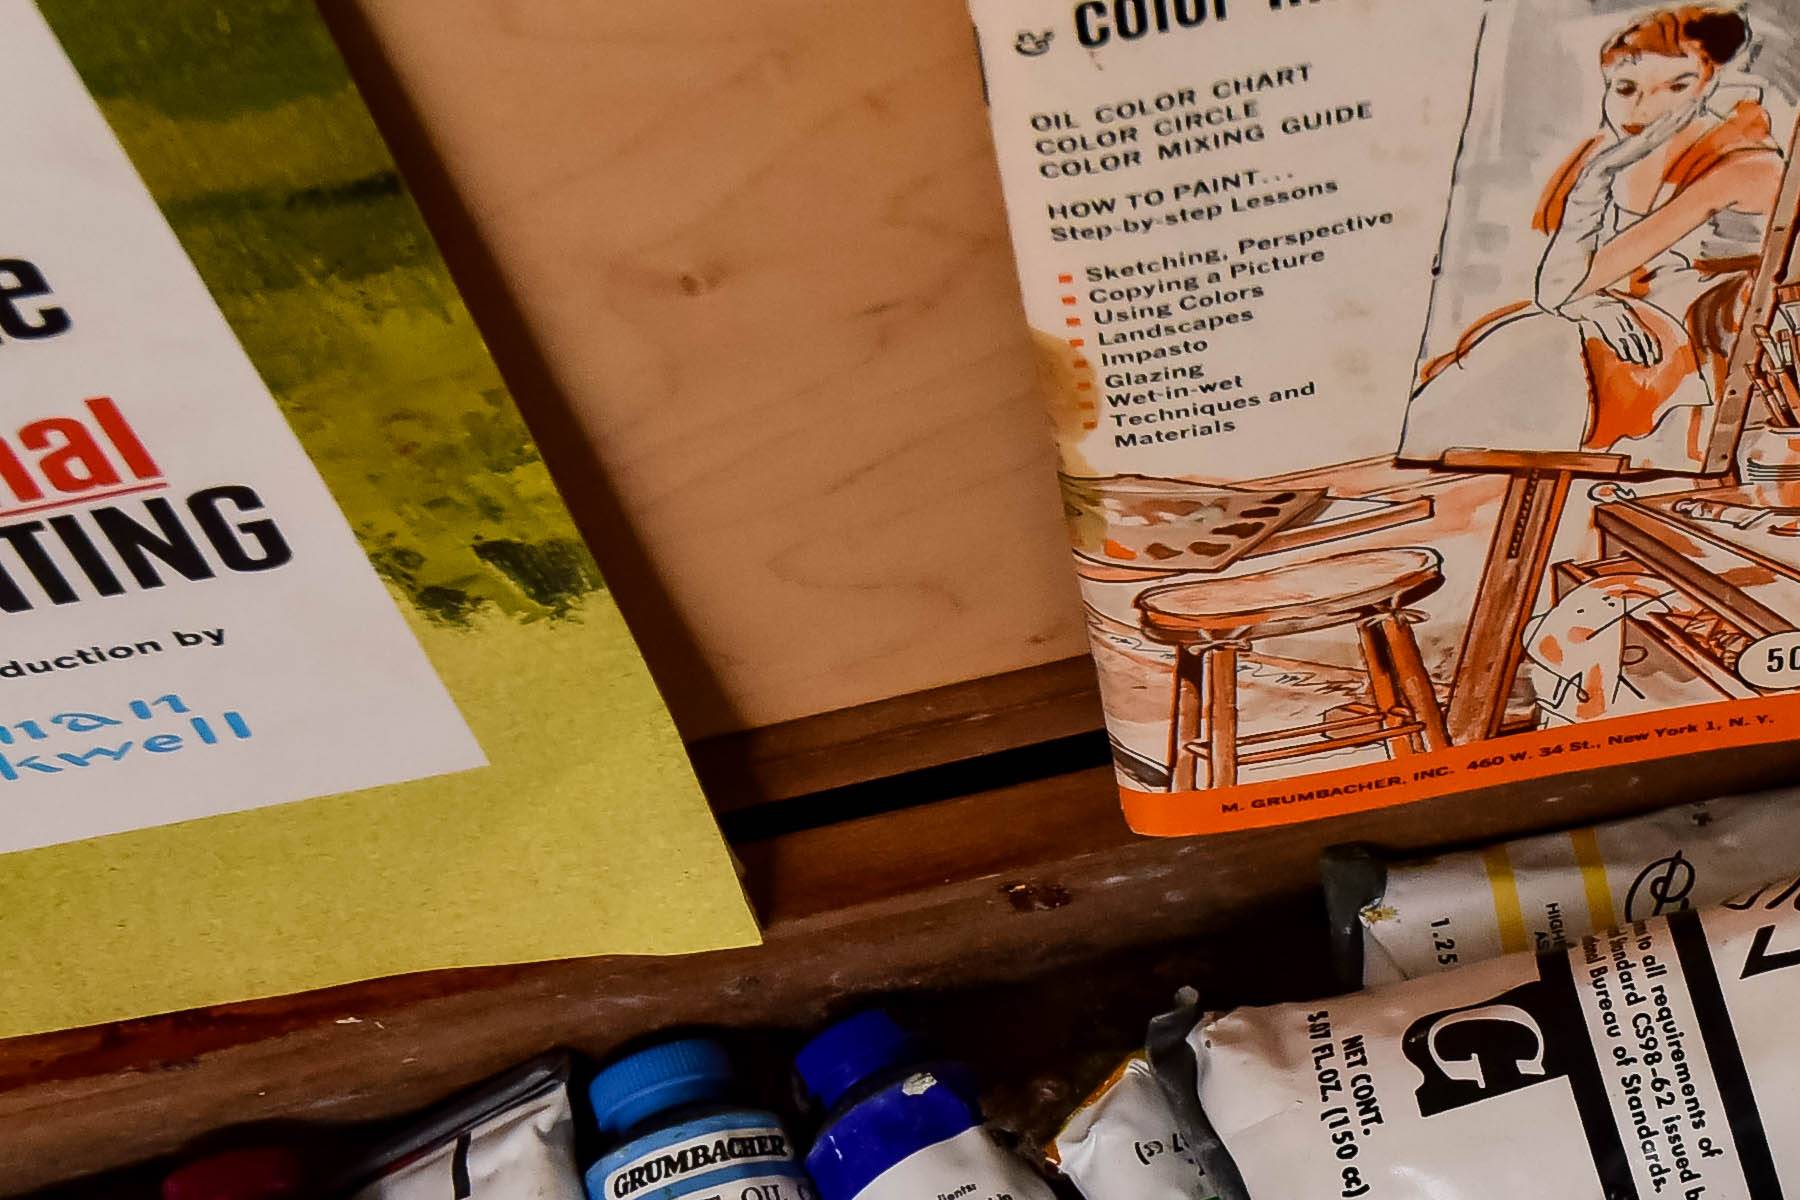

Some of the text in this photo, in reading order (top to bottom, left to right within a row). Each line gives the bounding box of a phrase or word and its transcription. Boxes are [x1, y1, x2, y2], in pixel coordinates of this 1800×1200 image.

[1031, 63, 1312, 132] OIL COLOR CHART
[1035, 102, 1259, 155] COLOR CIRCLE
[1040, 101, 1373, 178] COLOR MIXING GUIDE
[1048, 197, 1117, 220] HOW
[1129, 189, 1164, 210] TO
[1051, 180, 1339, 242] Step-by-step Lessons
[1086, 211, 1394, 284] Sketching, Perspective
[1089, 249, 1326, 305] Copying a Picture
[1094, 284, 1264, 326] Using Colors
[1099, 307, 1254, 347] Landscapes
[1101, 340, 1208, 366] Impasto
[1104, 362, 1204, 388] Glazing
[1106, 375, 1243, 408] Wet-in-wet
[1110, 382, 1316, 428] Techniques and
[1114, 418, 1236, 448] Materials
[0, 486, 292, 614] TING
[172, 628, 225, 648] by
[1251, 722, 1698, 809] GRUMBACHER, INC. 460 34 New York
[1589, 967, 1622, 1038] Bureau
[1311, 1044, 1343, 1102] FL.OZ.
[1612, 1046, 1638, 1068] of
[1642, 954, 1724, 1159] all requirements of
[1342, 1034, 1384, 1137] NET CONT.
[1631, 1012, 1676, 1110] CS98-62
[1662, 1116, 1702, 1182] issued
[1320, 1106, 1358, 1160] (150
[1618, 1073, 1672, 1194] Standards.
[614, 1135, 788, 1199] GRUMBACHER
[1342, 1165, 1370, 1198] cc)
